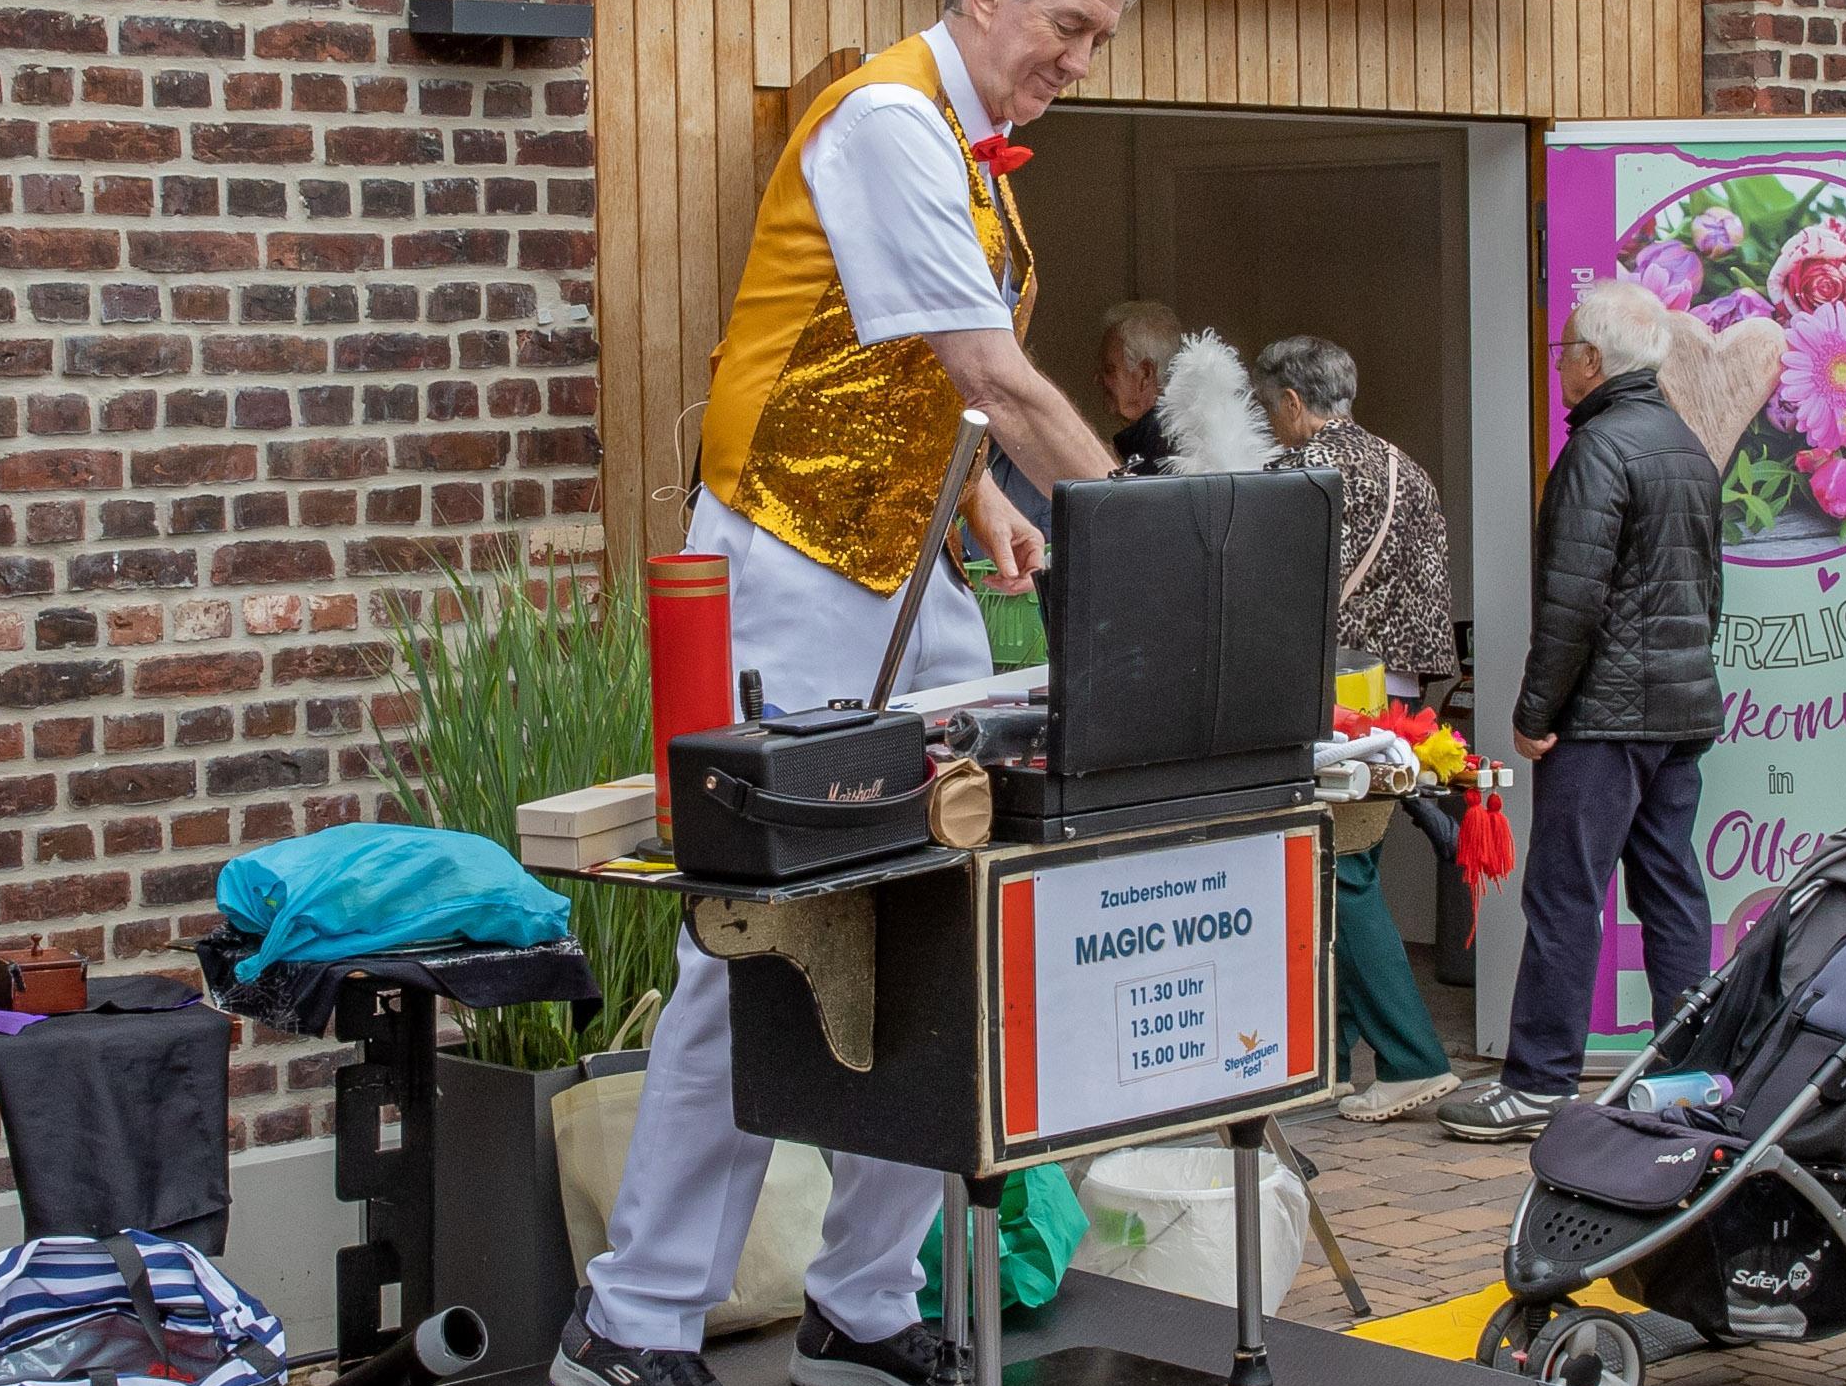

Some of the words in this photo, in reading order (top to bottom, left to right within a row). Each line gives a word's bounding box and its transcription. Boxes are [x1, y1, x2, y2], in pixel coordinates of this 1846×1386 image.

[827, 778, 884, 802] Marshall
[1768, 765, 1794, 794] in
[1101, 879, 1196, 909] Zaubershow
[1202, 871, 1227, 892] mit
[1075, 923, 1165, 965] MAGIC
[1172, 907, 1253, 947] WOBO
[1130, 982, 1173, 1006] 11.30
[1178, 977, 1204, 998] Uhr
[1131, 1013, 1173, 1037] 13.00
[1178, 1009, 1205, 1029] Uhr
[1132, 1045, 1174, 1069] 15.00
[1179, 1041, 1205, 1060] Uhr
[1225, 1043, 1278, 1072] Steverauen
[1243, 1060, 1261, 1079] Fest
[1791, 1269, 1808, 1283] 1st
